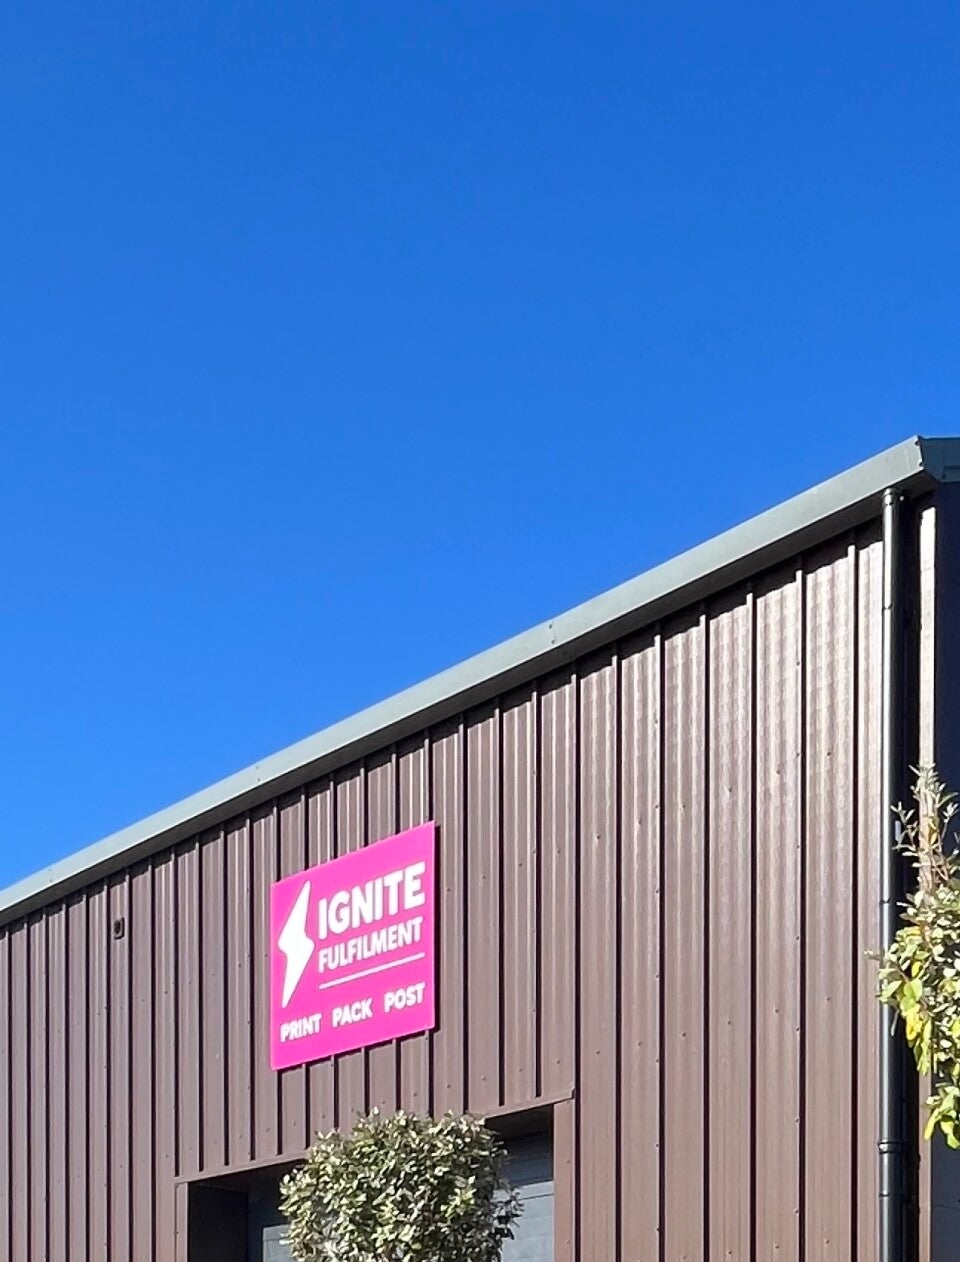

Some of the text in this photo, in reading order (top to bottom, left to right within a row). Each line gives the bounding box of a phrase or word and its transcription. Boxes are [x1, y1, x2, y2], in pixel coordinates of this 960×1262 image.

[318, 861, 426, 940] IGNITE
[318, 916, 424, 974] FULFILMENT
[280, 982, 426, 1043] PRINT PACK POST
